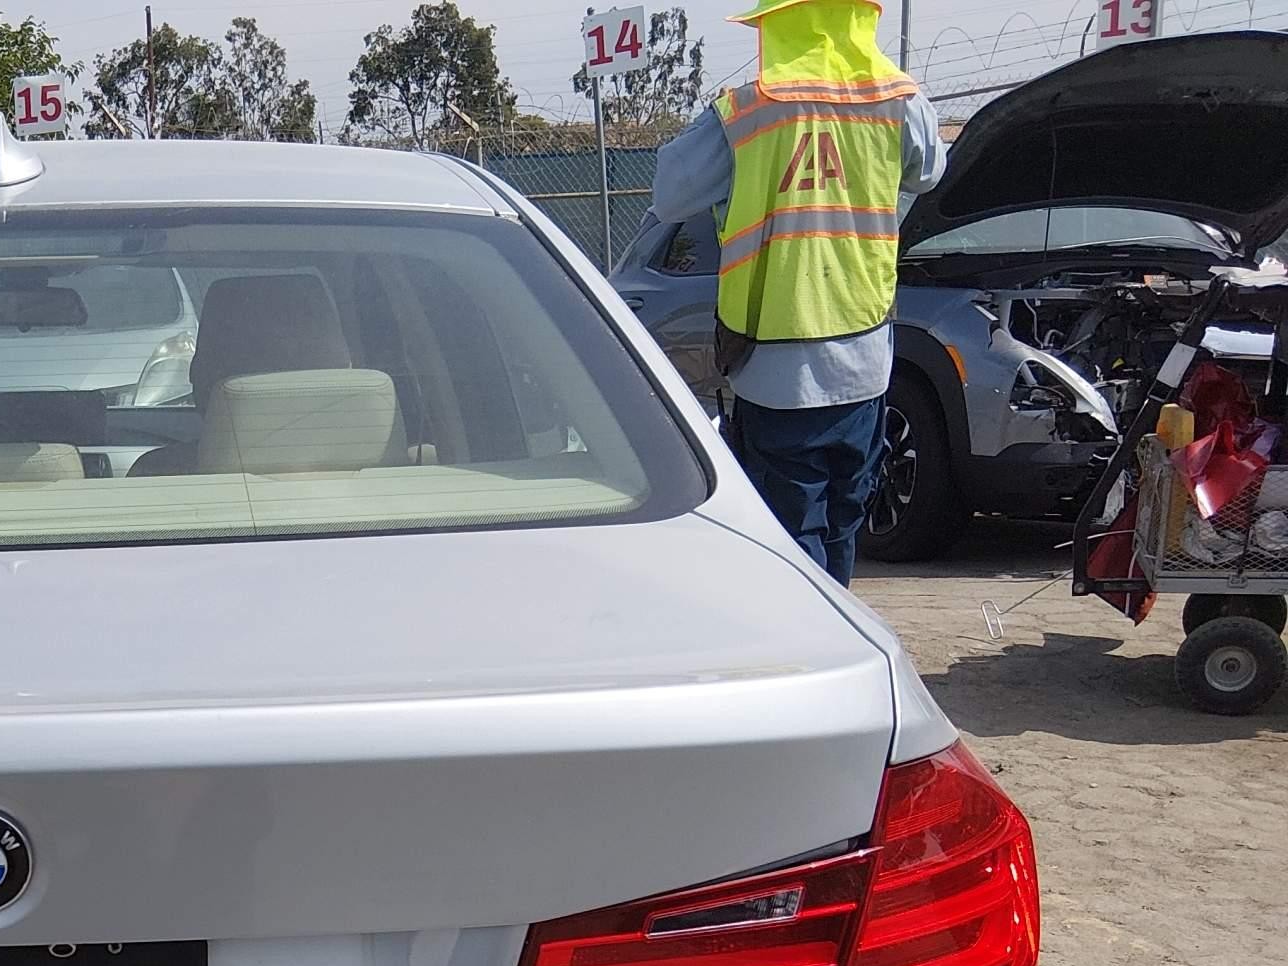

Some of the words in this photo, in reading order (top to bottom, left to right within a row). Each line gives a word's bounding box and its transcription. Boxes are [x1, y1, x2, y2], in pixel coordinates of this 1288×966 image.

[1100, 0, 1153, 38] 13
[587, 19, 643, 66] 14
[17, 84, 62, 125] 15
